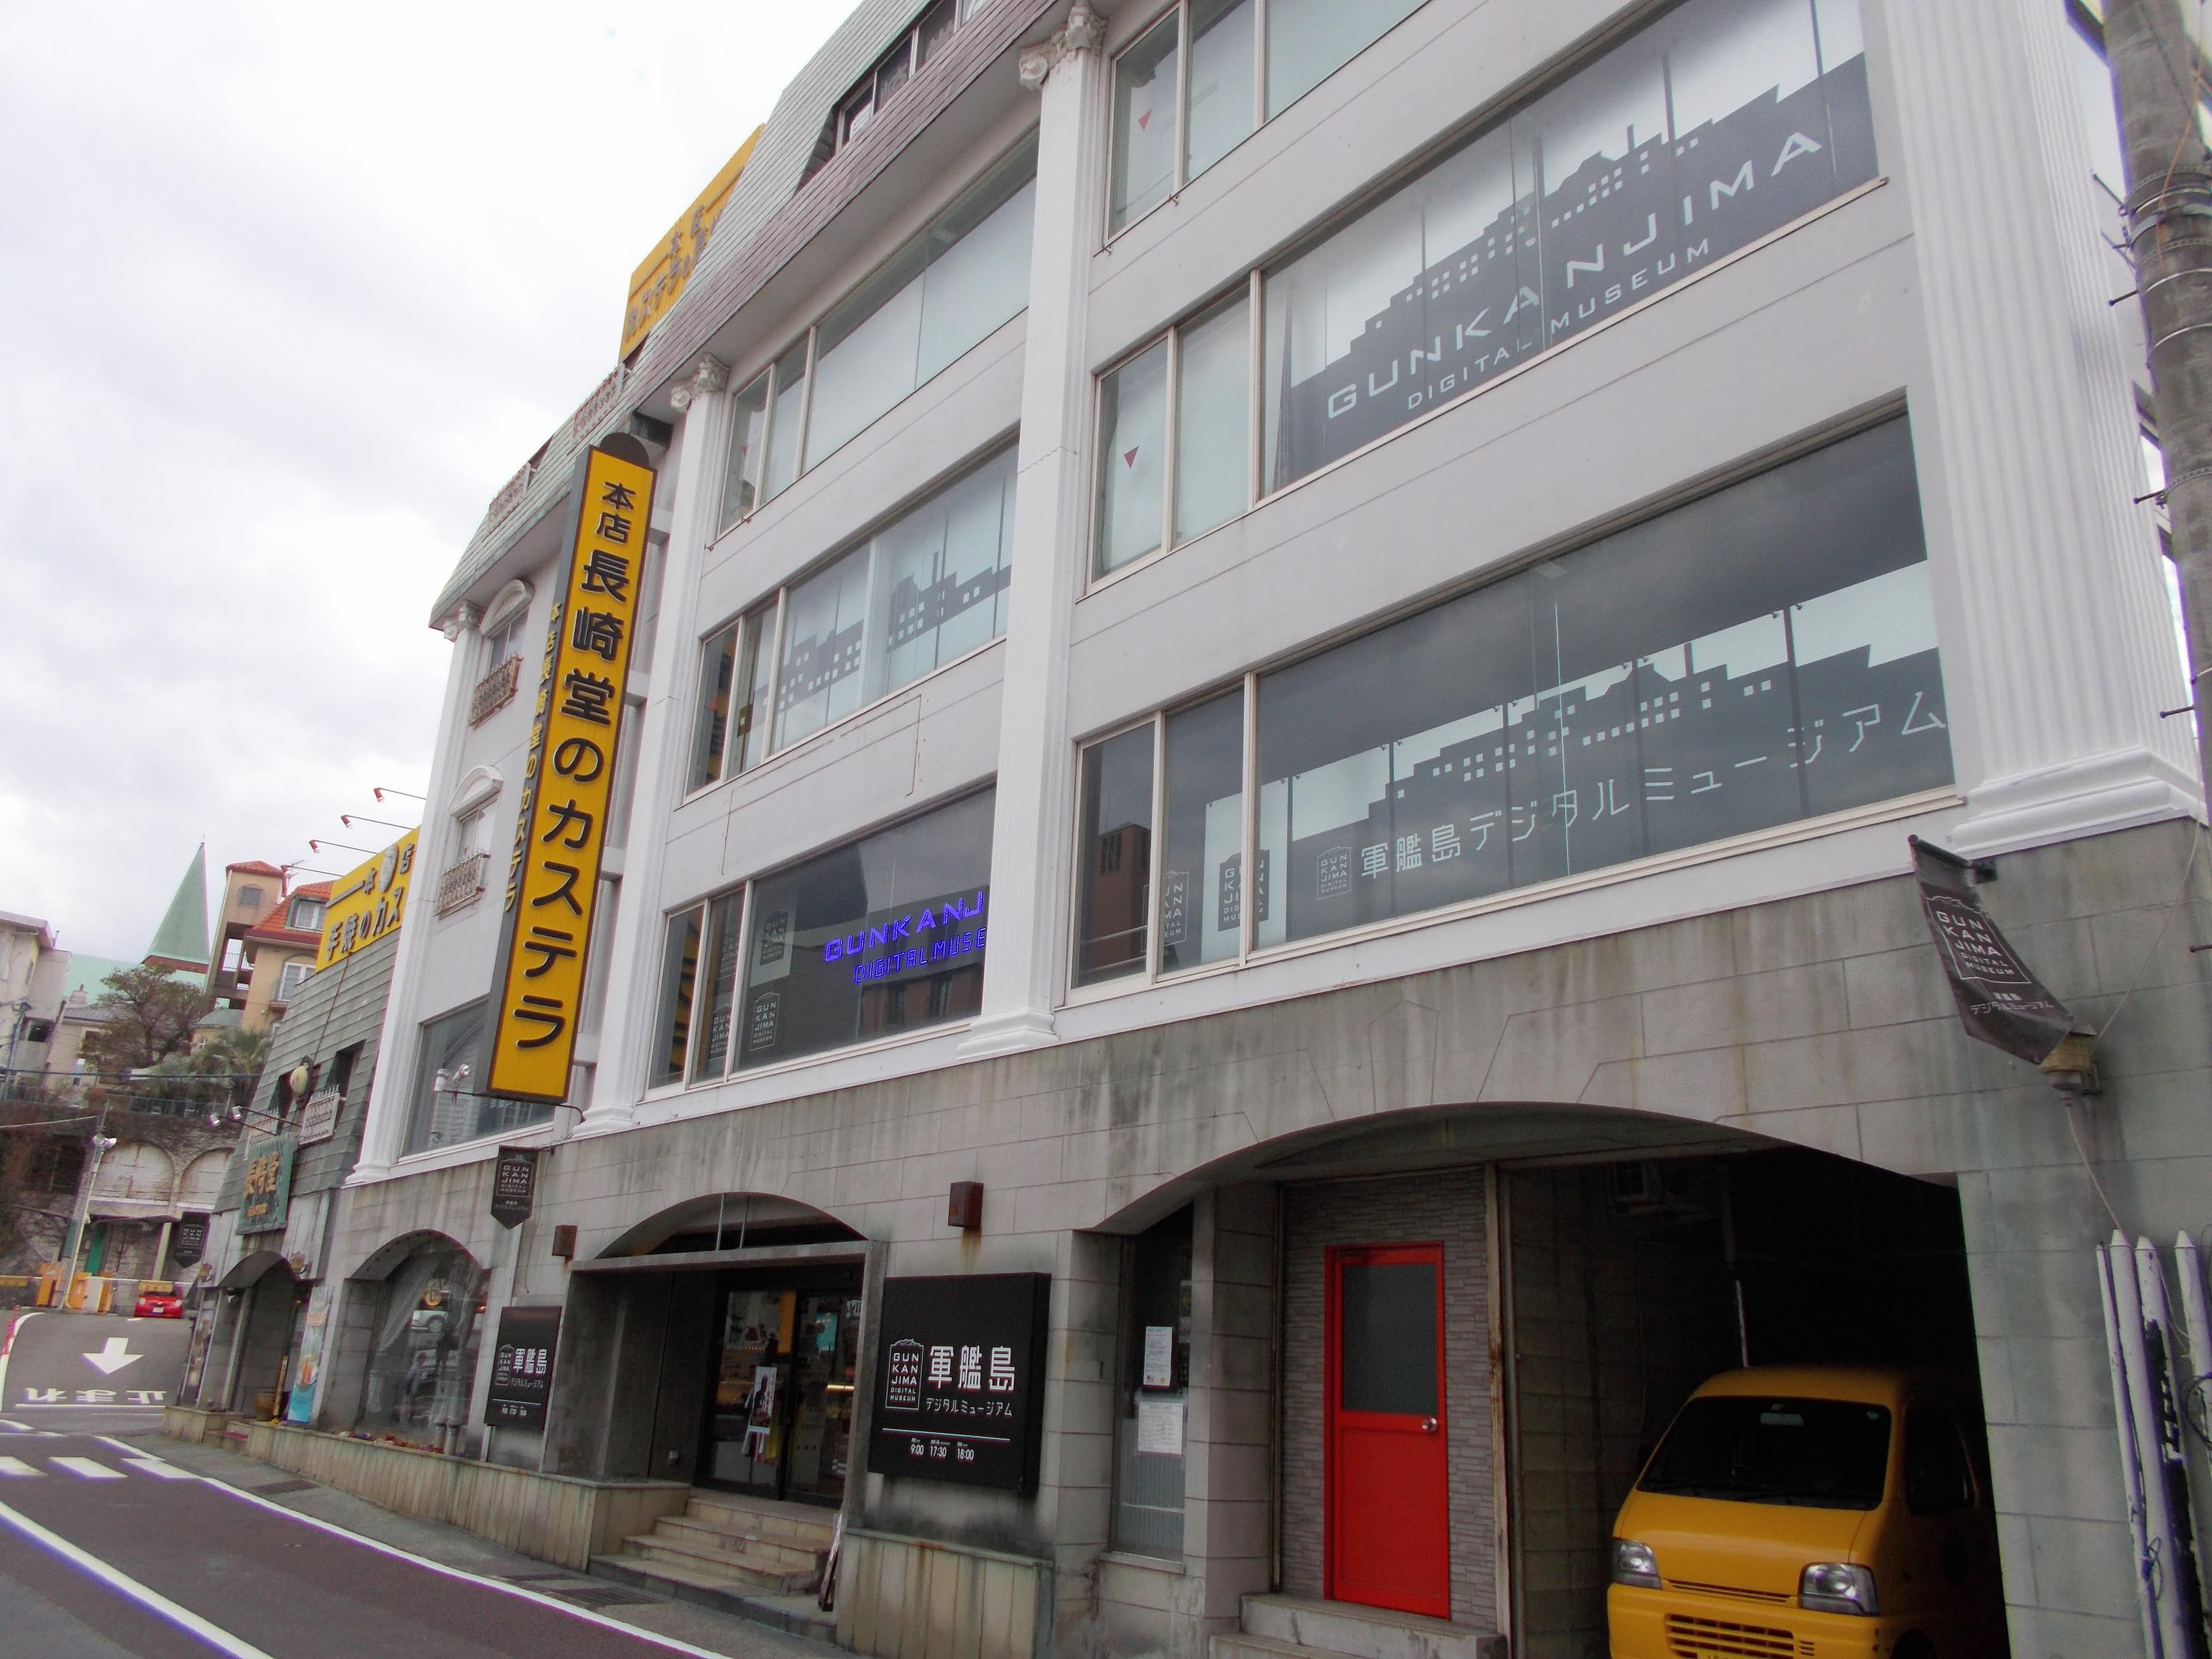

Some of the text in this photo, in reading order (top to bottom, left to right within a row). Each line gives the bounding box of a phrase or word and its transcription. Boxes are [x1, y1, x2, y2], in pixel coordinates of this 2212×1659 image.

[1328, 130, 1824, 419] GUNKANJIMA
[1407, 237, 1710, 410] DIGITAL MUSEUM
[1361, 691, 1946, 879] 軍艦島デジタルミュージアム
[1321, 853, 1347, 866] GUN
[1321, 861, 1347, 874] KAN
[1321, 870, 1347, 882] JIMA
[824, 891, 984, 963] GUNKANJ
[1936, 910, 1983, 930] GUN
[764, 936, 783, 947] JIMA
[1943, 925, 1992, 944] KAN
[854, 927, 987, 984] DIGITAL MUSE
[1955, 941, 2002, 957] JIMA
[1961, 951, 2008, 967] DIGITAL
[1965, 961, 2014, 975] MUSEUM
[756, 1001, 777, 1013] GUN
[755, 1011, 775, 1022] KAN
[755, 1021, 774, 1031] JIMA
[893, 1353, 919, 1362] GUN
[892, 1364, 918, 1374] KAN
[928, 1344, 1016, 1392] 軍艦島
[891, 1375, 917, 1385] JIMA
[926, 1397, 1013, 1416] デジタルミュージアム
[911, 1444, 975, 1461] 9:00 17:30 18:00
